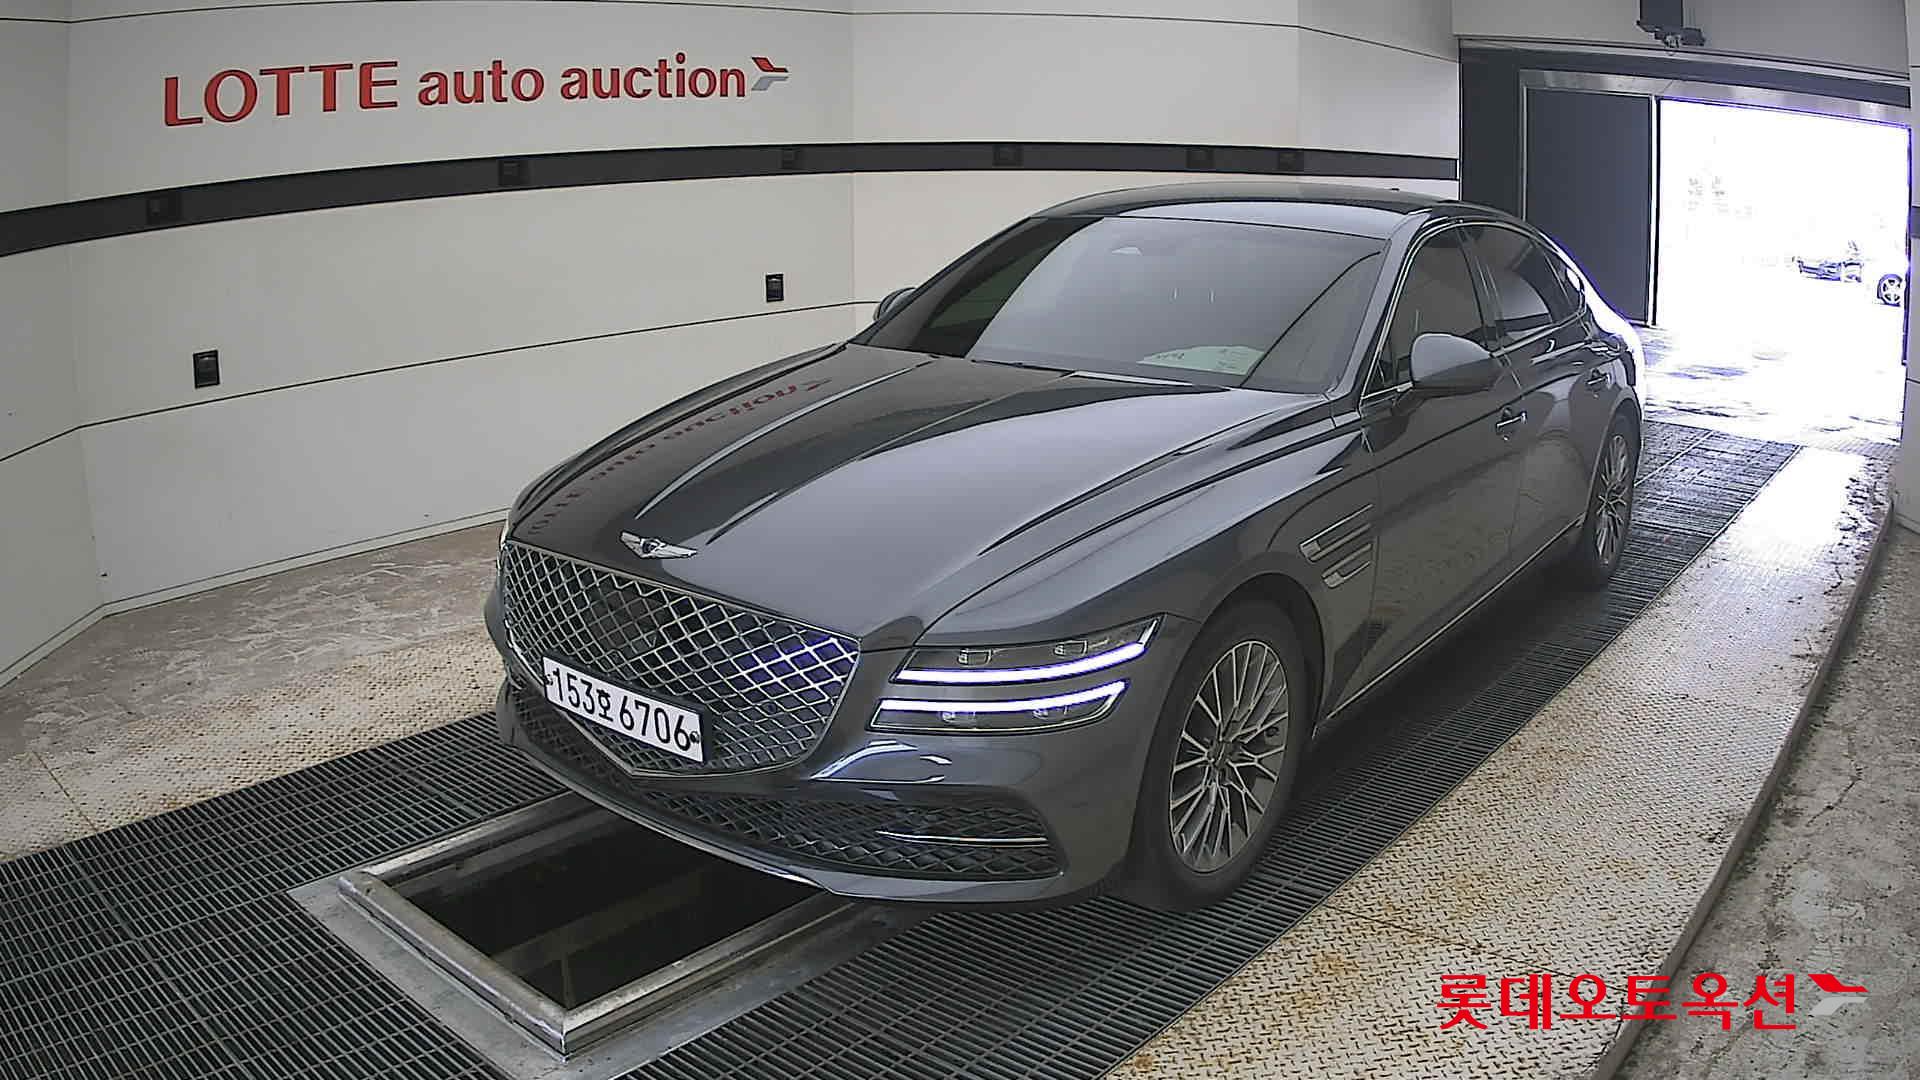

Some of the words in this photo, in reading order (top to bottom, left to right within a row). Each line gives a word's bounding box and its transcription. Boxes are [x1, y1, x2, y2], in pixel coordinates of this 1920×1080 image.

[164, 61, 398, 127] LOTTE
[417, 60, 545, 106] auto
[560, 53, 746, 101] auction
